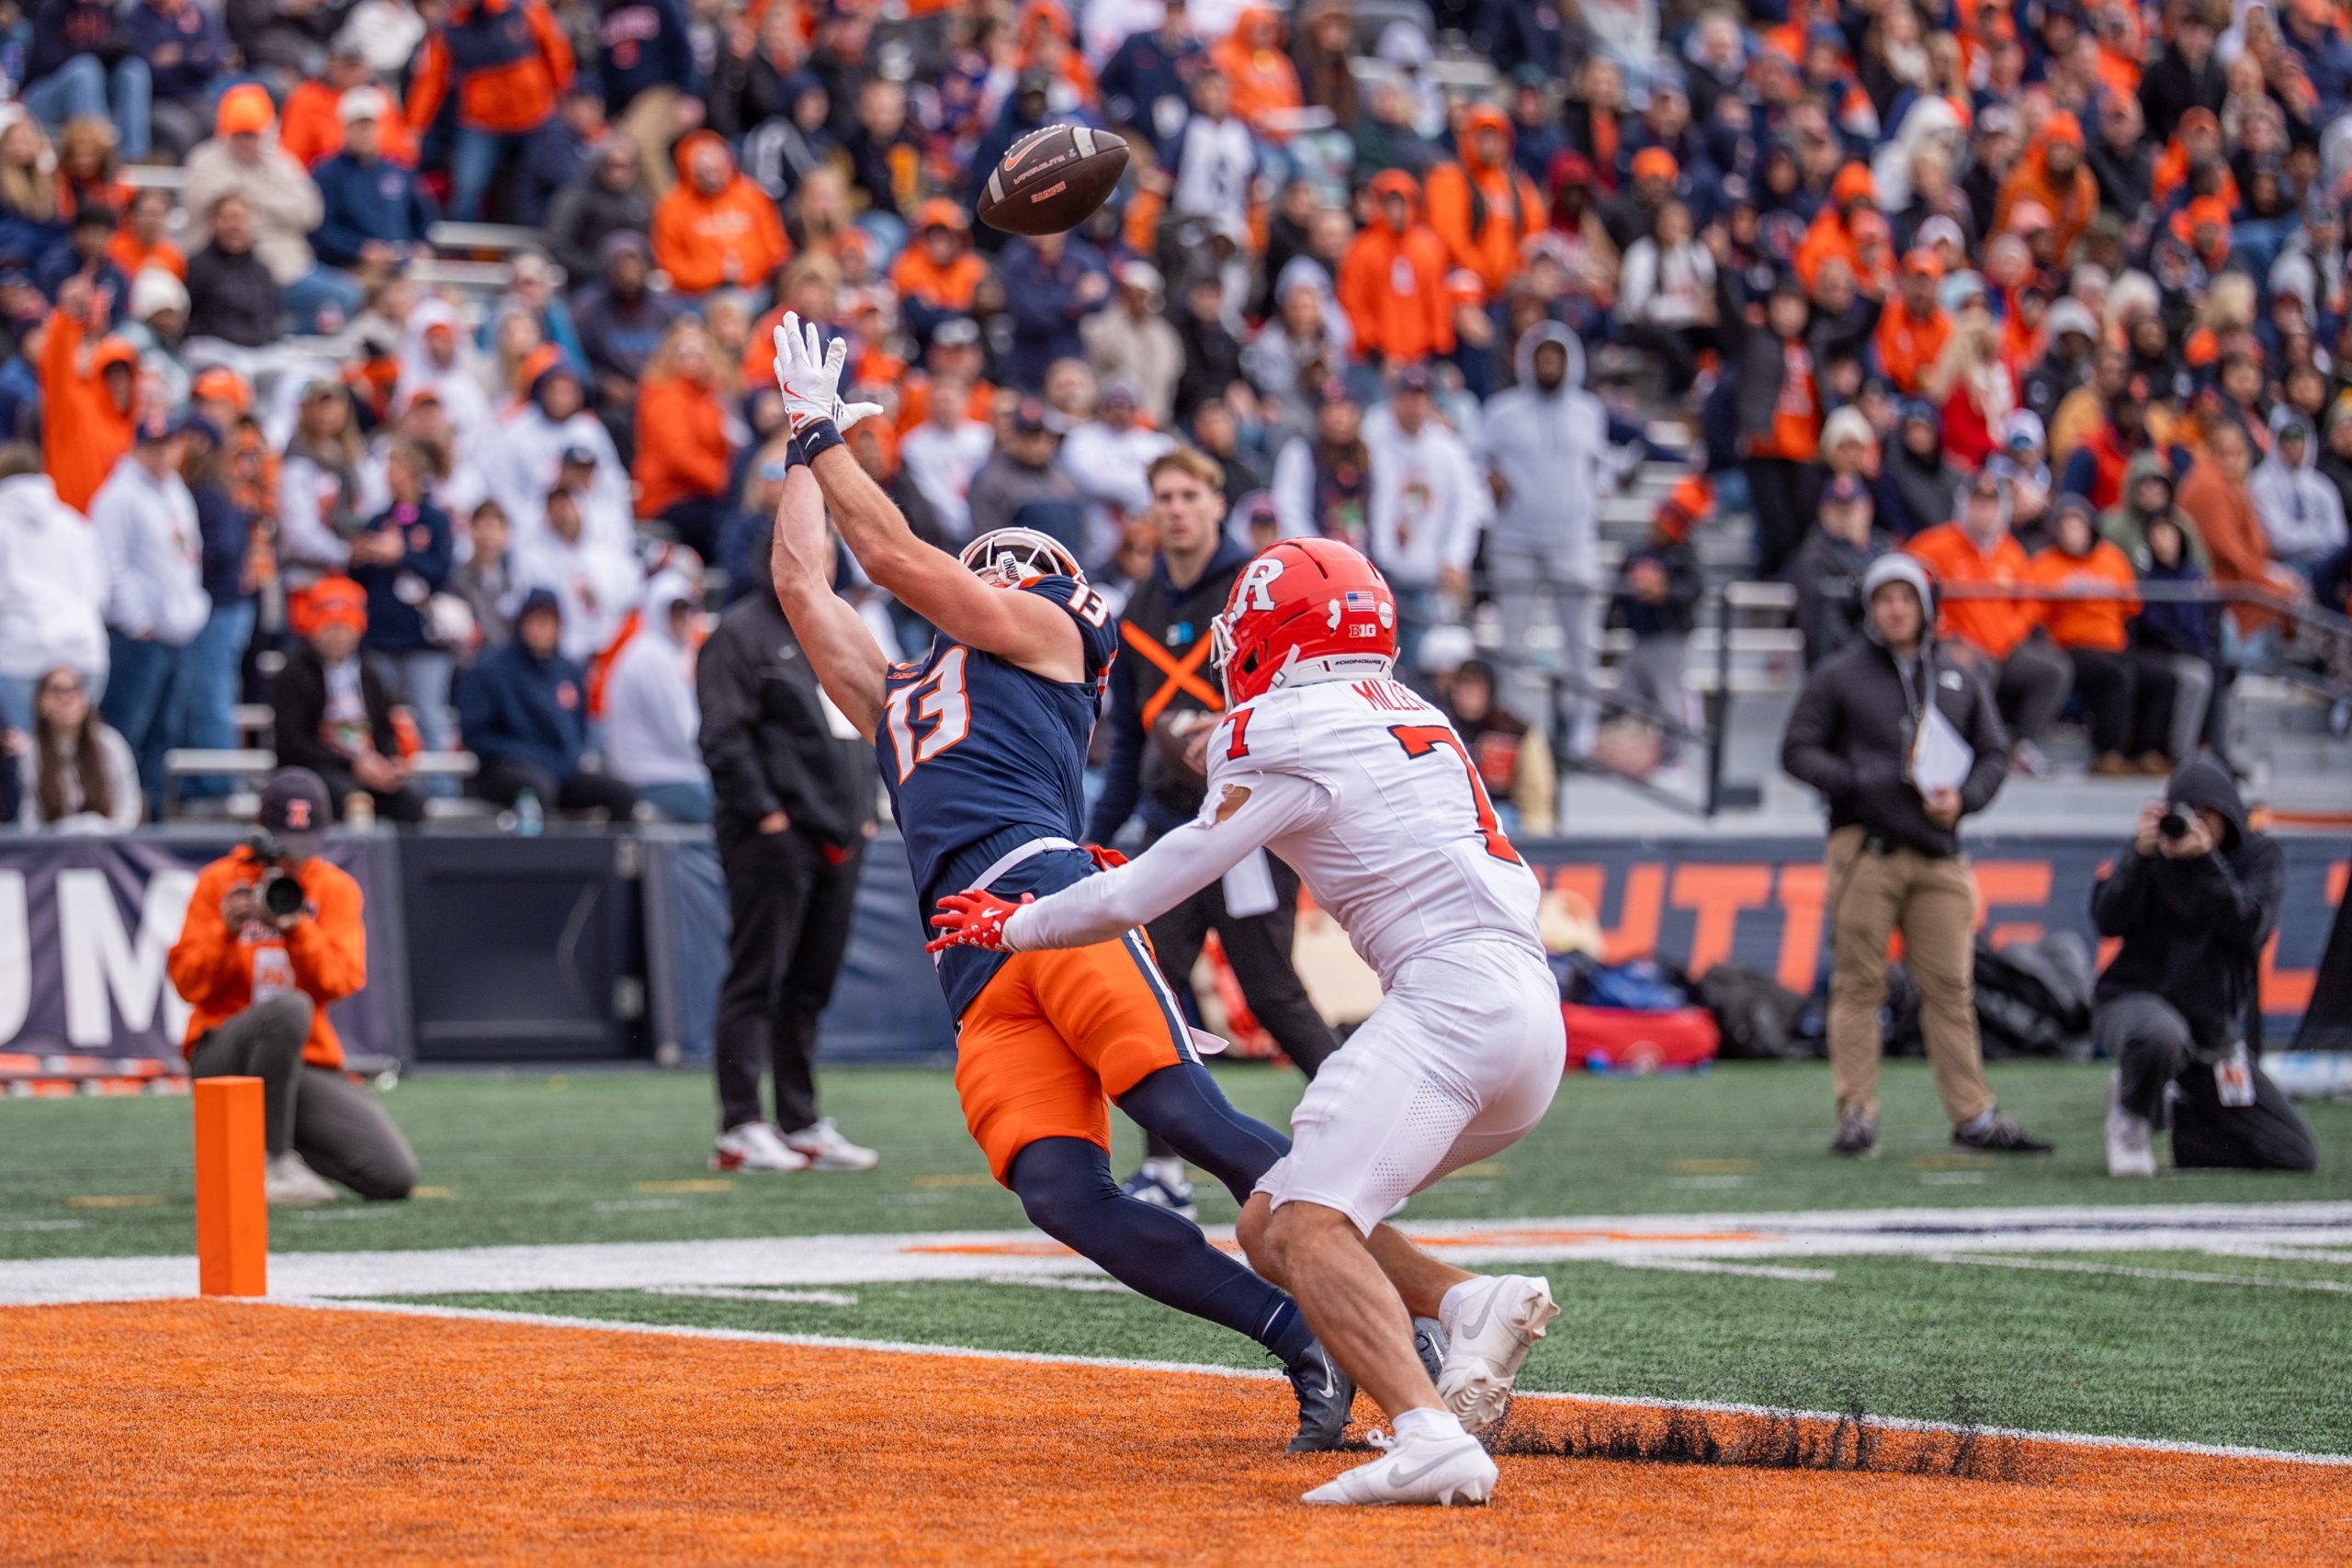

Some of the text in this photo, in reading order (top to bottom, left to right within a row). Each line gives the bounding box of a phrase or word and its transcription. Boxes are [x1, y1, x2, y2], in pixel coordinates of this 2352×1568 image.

[1067, 580, 1109, 629] 13
[1232, 558, 1285, 621] R
[885, 645, 971, 786] 13
[1222, 706, 1255, 761] 7
[1386, 723, 1524, 867] 7
